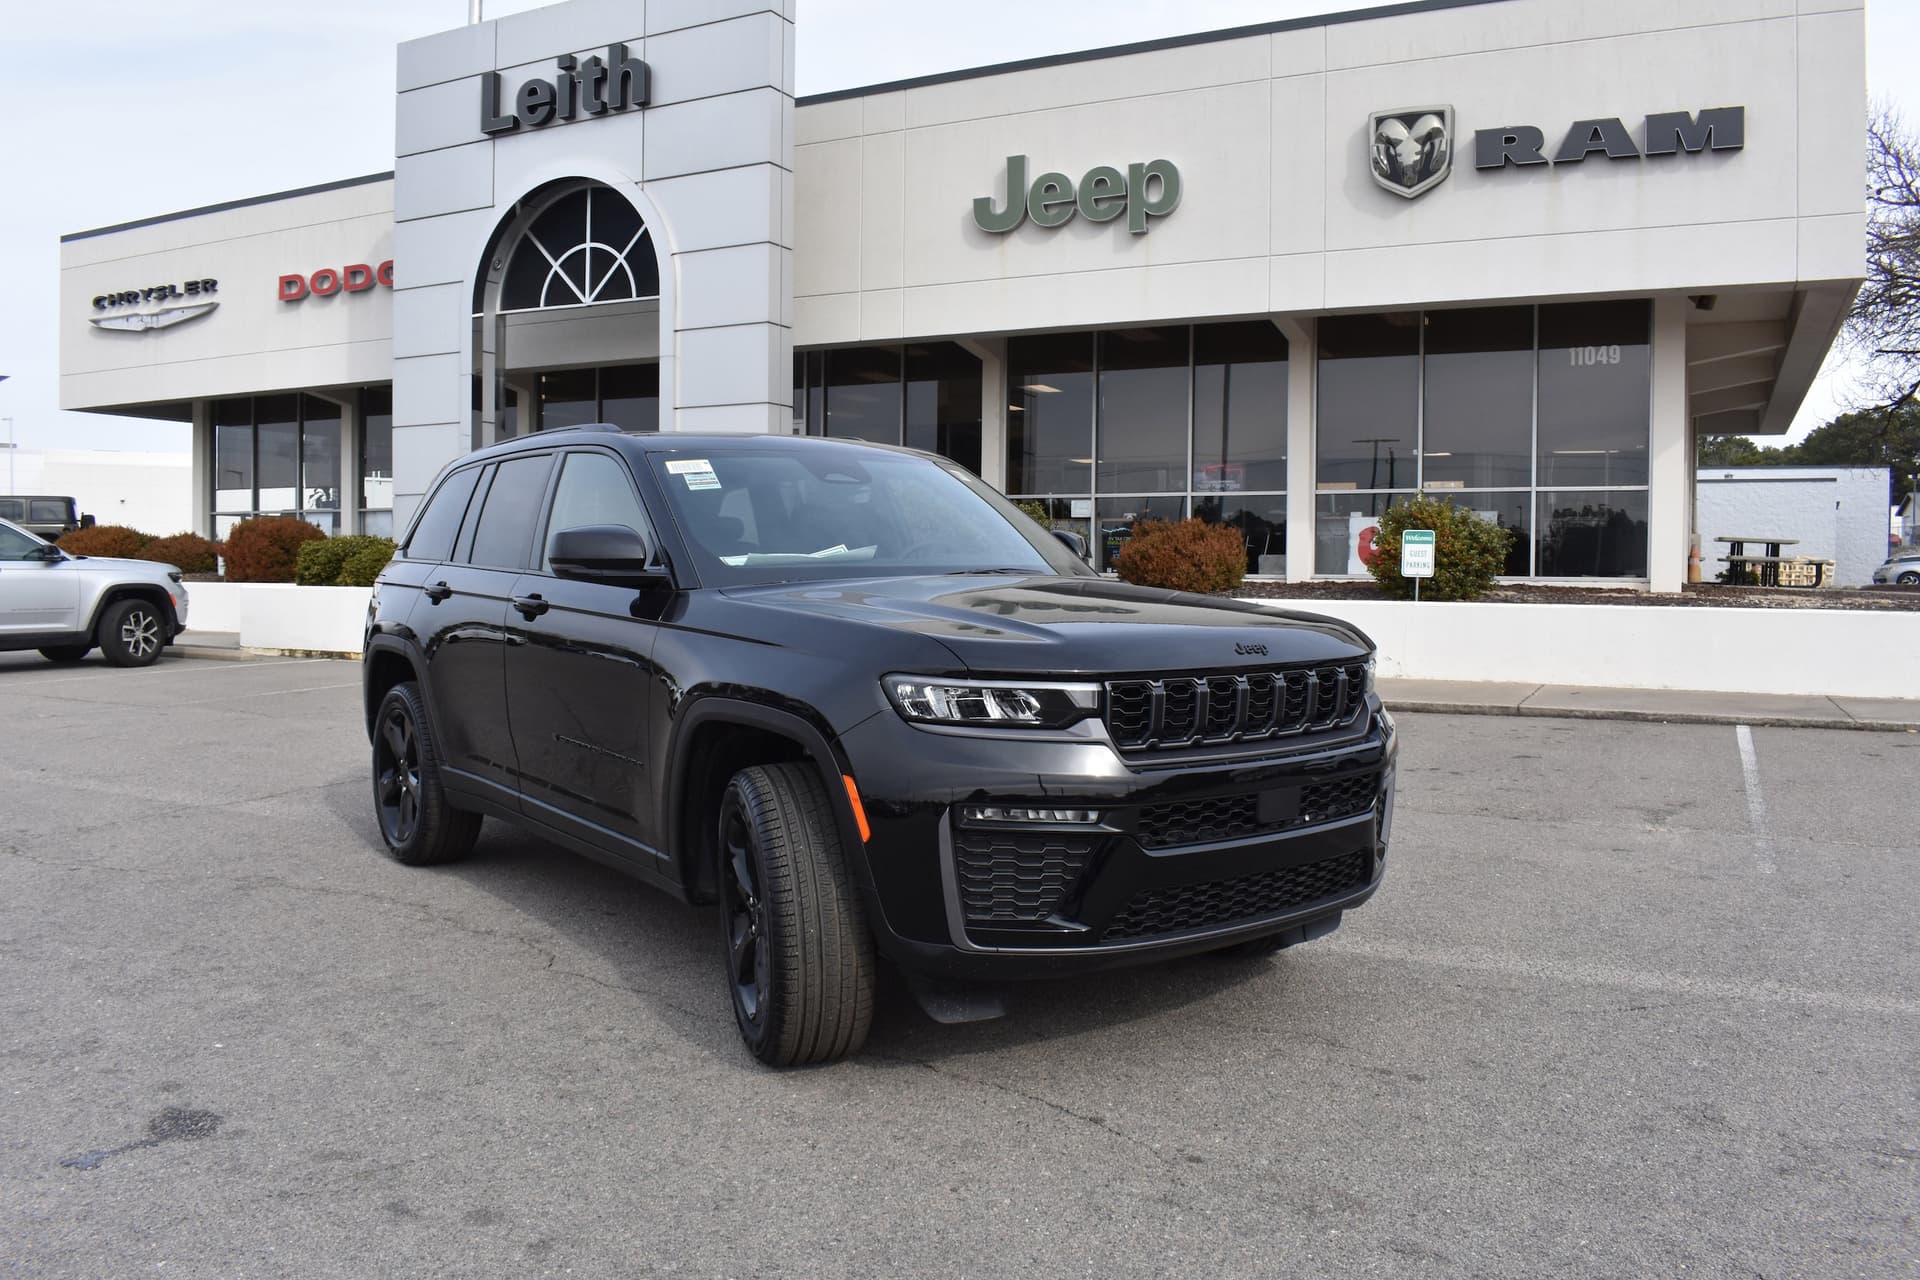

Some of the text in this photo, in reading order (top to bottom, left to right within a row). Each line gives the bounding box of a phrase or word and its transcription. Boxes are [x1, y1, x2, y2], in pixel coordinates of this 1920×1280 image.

[481, 43, 651, 135] Leith
[1475, 106, 1744, 170] RAM
[973, 154, 1182, 236] Jeep
[92, 278, 218, 310] CHRYSLER
[279, 260, 393, 300] DODG
[1569, 345, 1621, 366] 11049
[1405, 561, 1431, 569] PARKING
[1409, 550, 1428, 558] GUEST
[1235, 641, 1269, 656] Jeep
